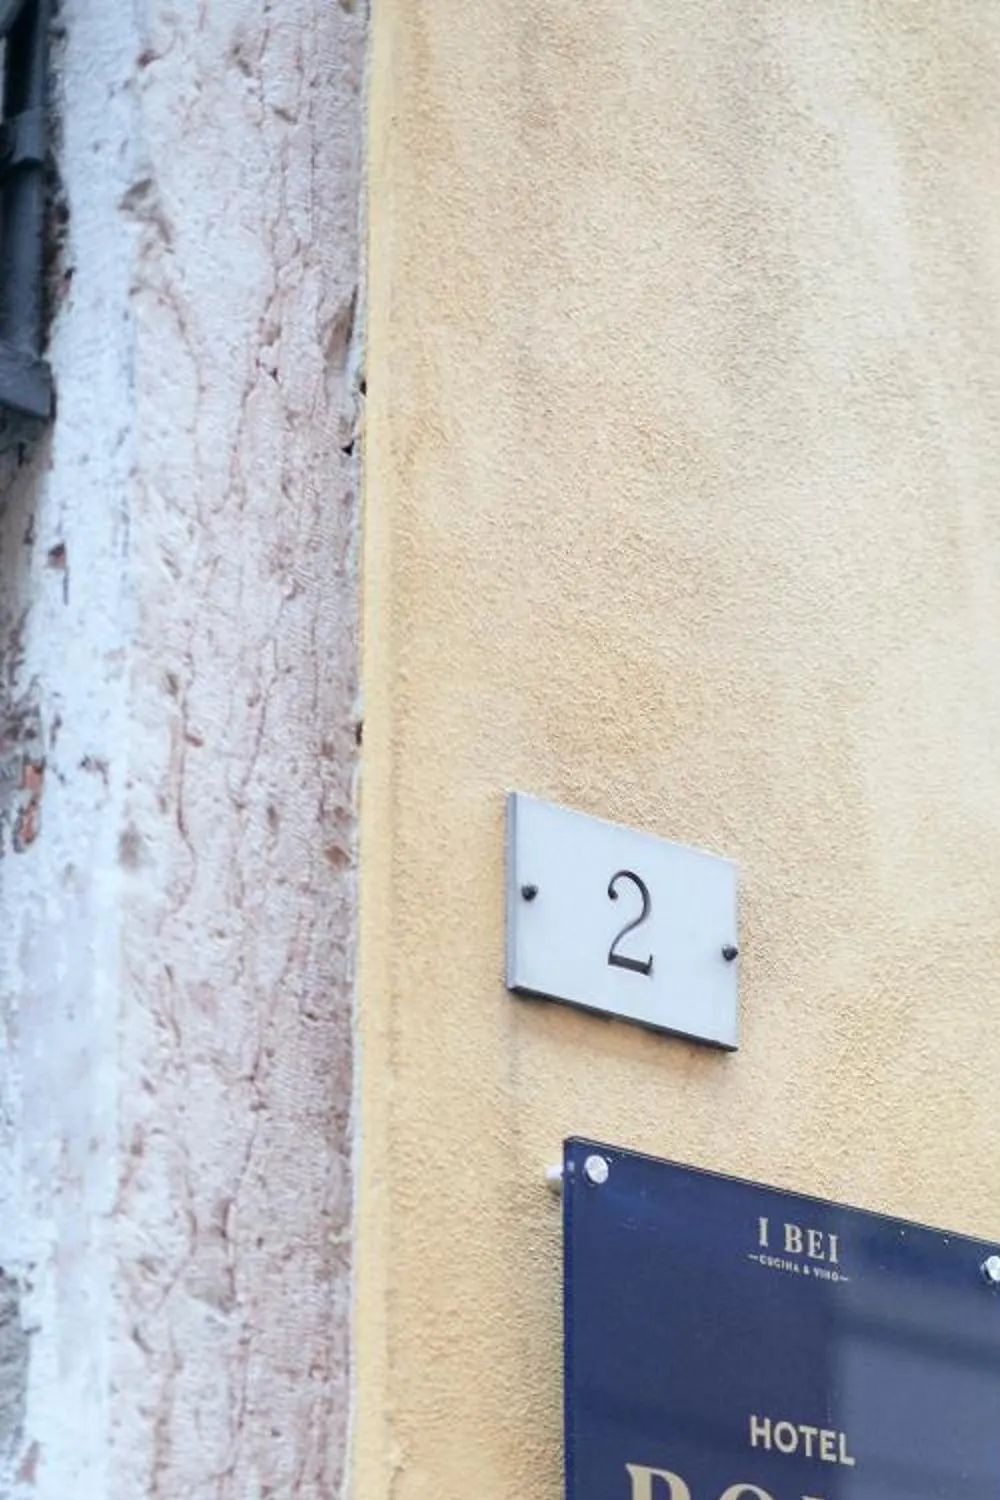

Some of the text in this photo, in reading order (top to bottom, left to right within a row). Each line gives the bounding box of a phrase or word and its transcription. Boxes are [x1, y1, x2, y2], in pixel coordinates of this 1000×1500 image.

[607, 869, 653, 979] 2
[759, 1217, 838, 1263] I BEI
[750, 1415, 855, 1466] HOTEL
